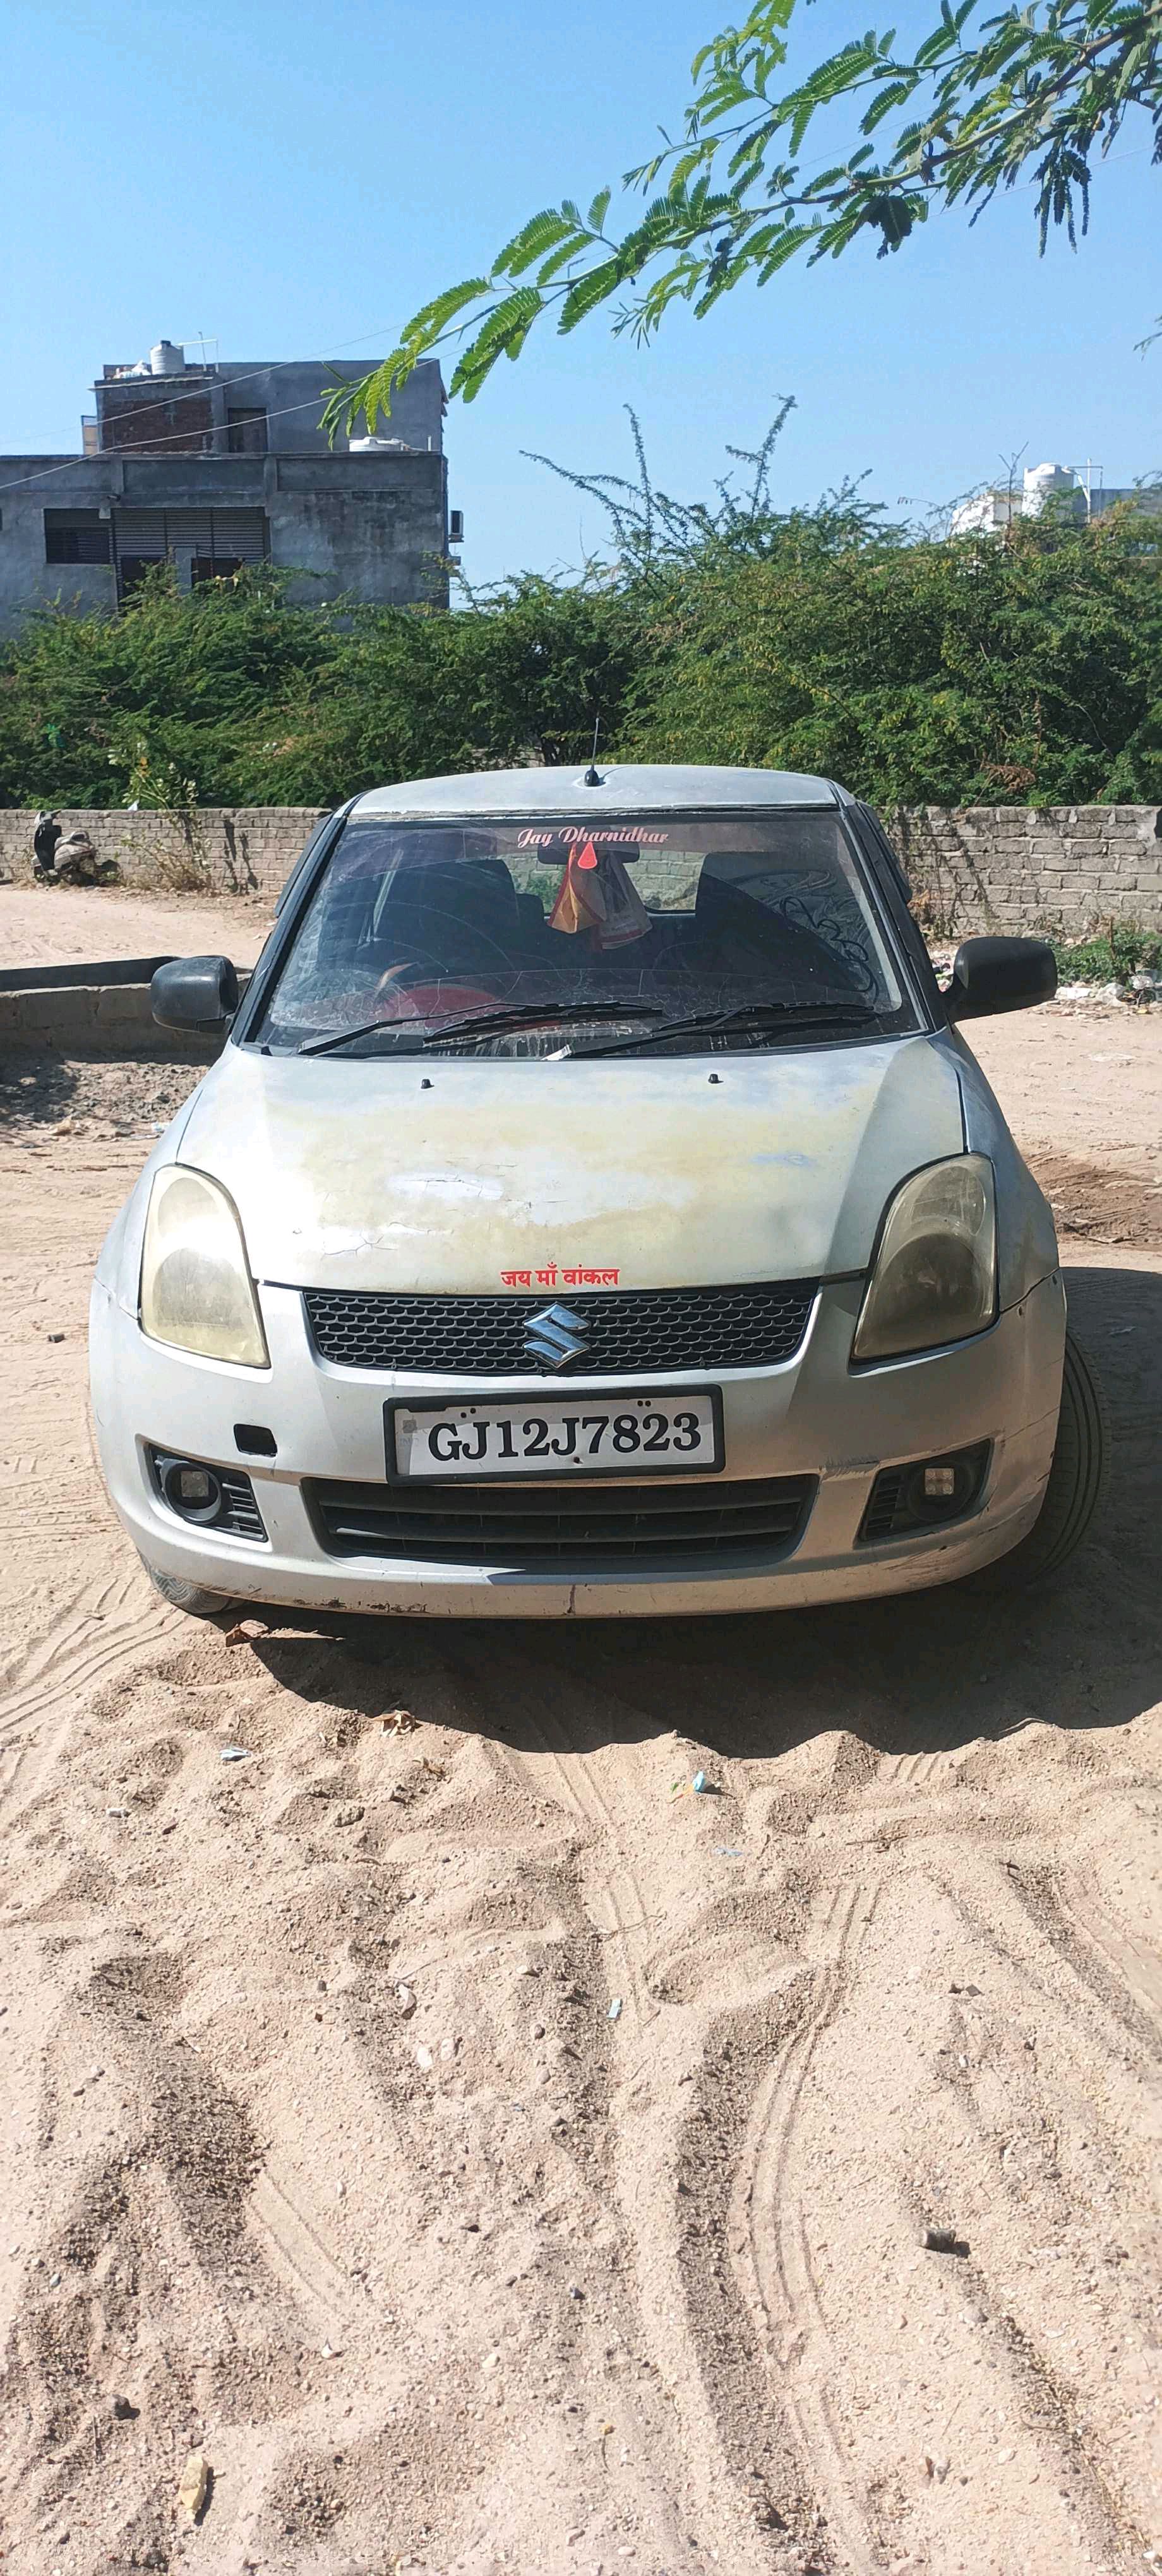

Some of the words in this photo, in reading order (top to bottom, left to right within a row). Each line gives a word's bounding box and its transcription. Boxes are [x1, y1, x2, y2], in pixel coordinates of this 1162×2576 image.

[517, 828, 554, 849] Jay
[558, 826, 669, 844] Dharnidhar
[500, 1270, 532, 1287] जय
[535, 1261, 558, 1286] माँ
[561, 1264, 621, 1286] वांकल
[428, 1412, 702, 1462] GJ12J7823
